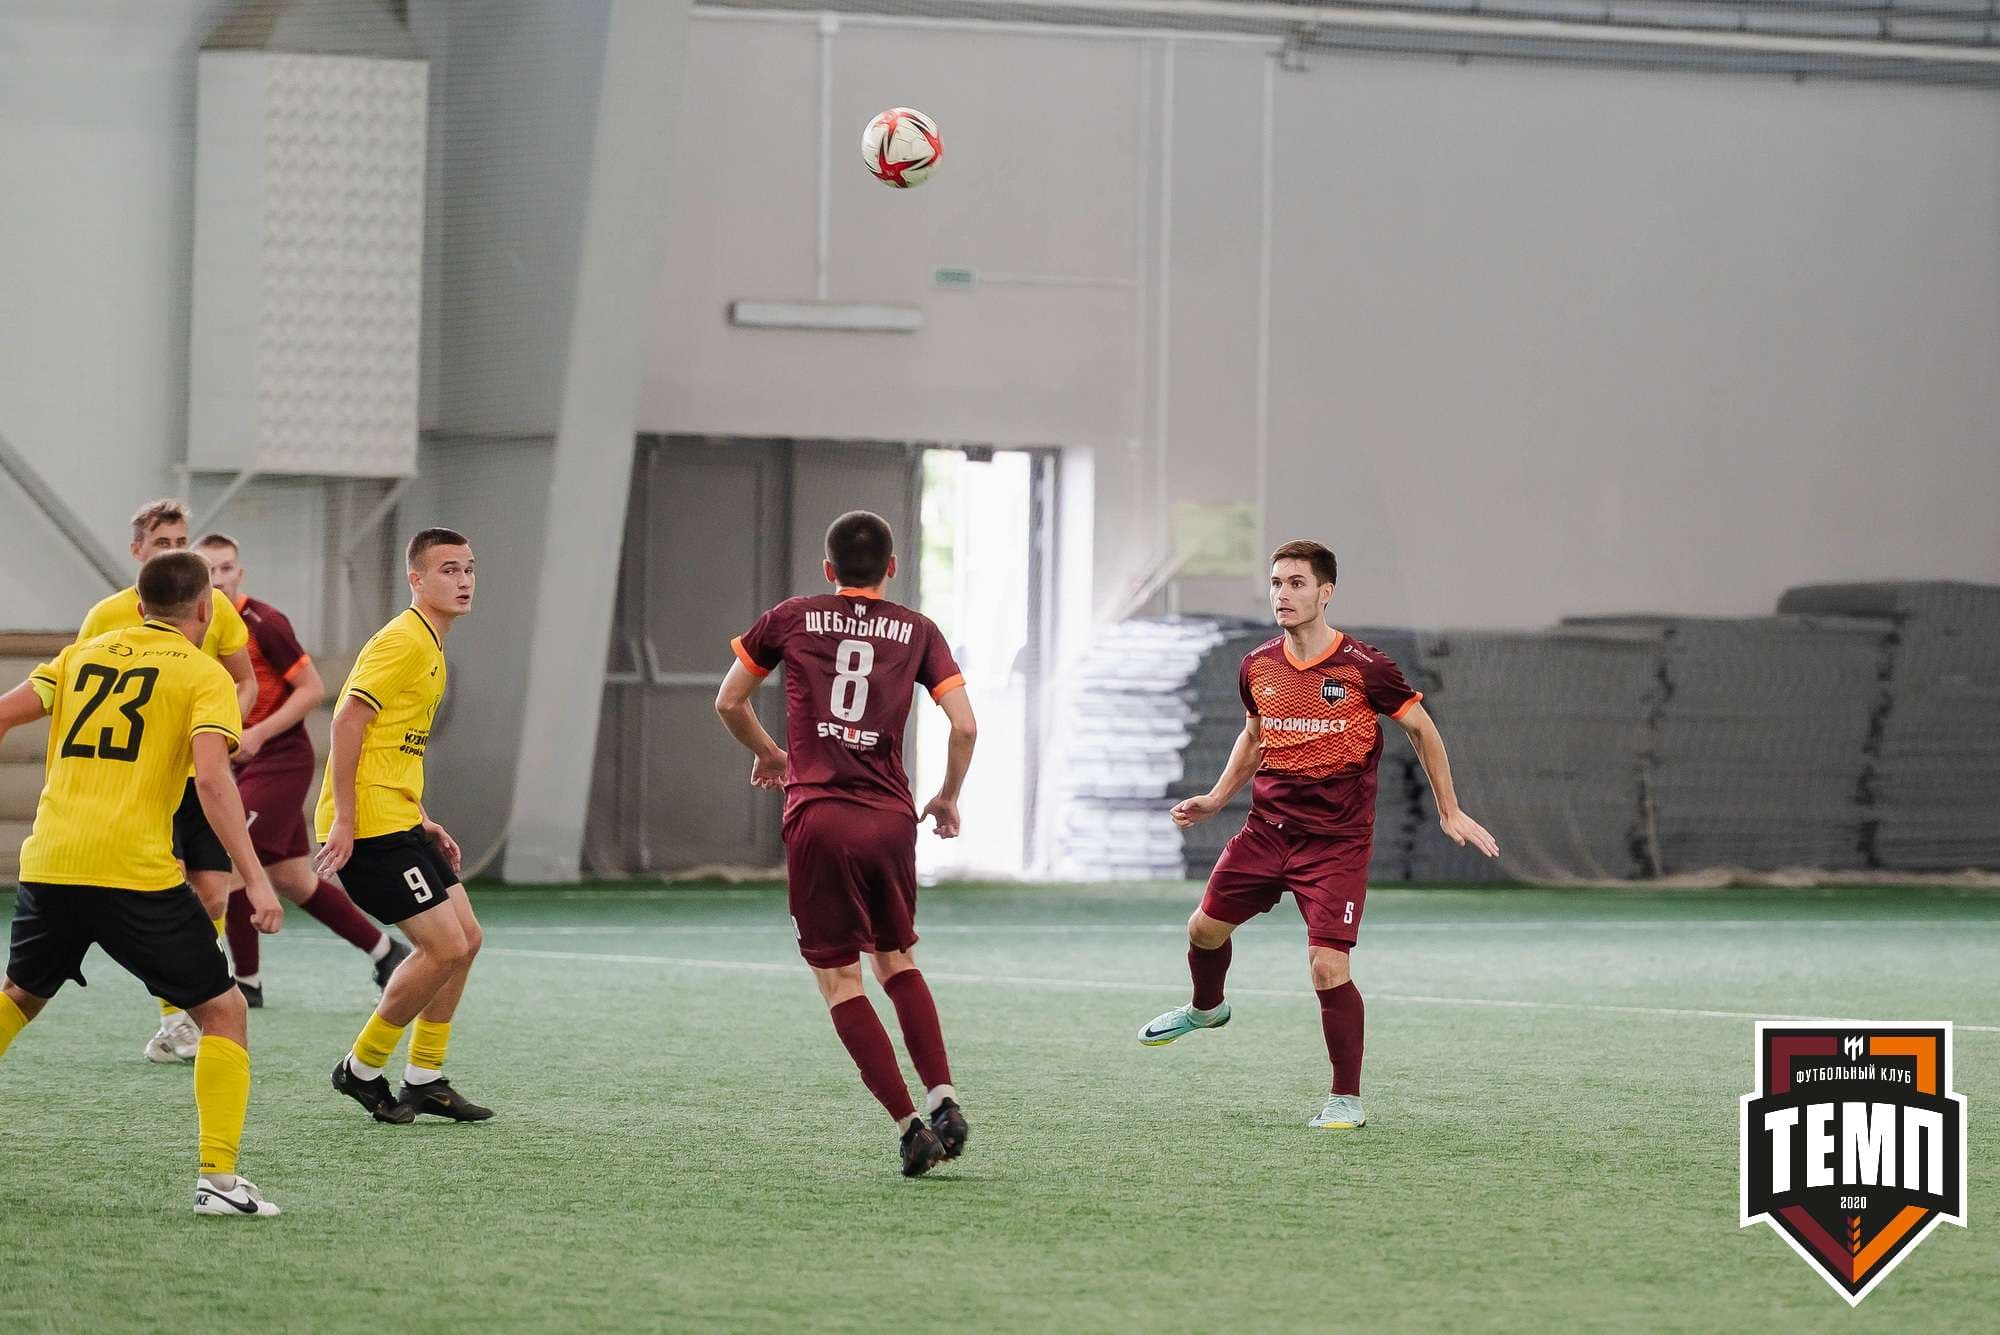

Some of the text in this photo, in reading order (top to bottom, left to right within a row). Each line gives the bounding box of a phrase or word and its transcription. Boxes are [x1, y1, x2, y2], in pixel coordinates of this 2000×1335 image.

[805, 610, 913, 644] ЩЕБЛЫКИН
[830, 639, 874, 722] 8
[1323, 686, 1344, 698] ТЕМП
[61, 663, 160, 762] 23
[817, 722, 880, 746] SEUS
[403, 866, 433, 903] 9
[1343, 901, 1355, 924] 5
